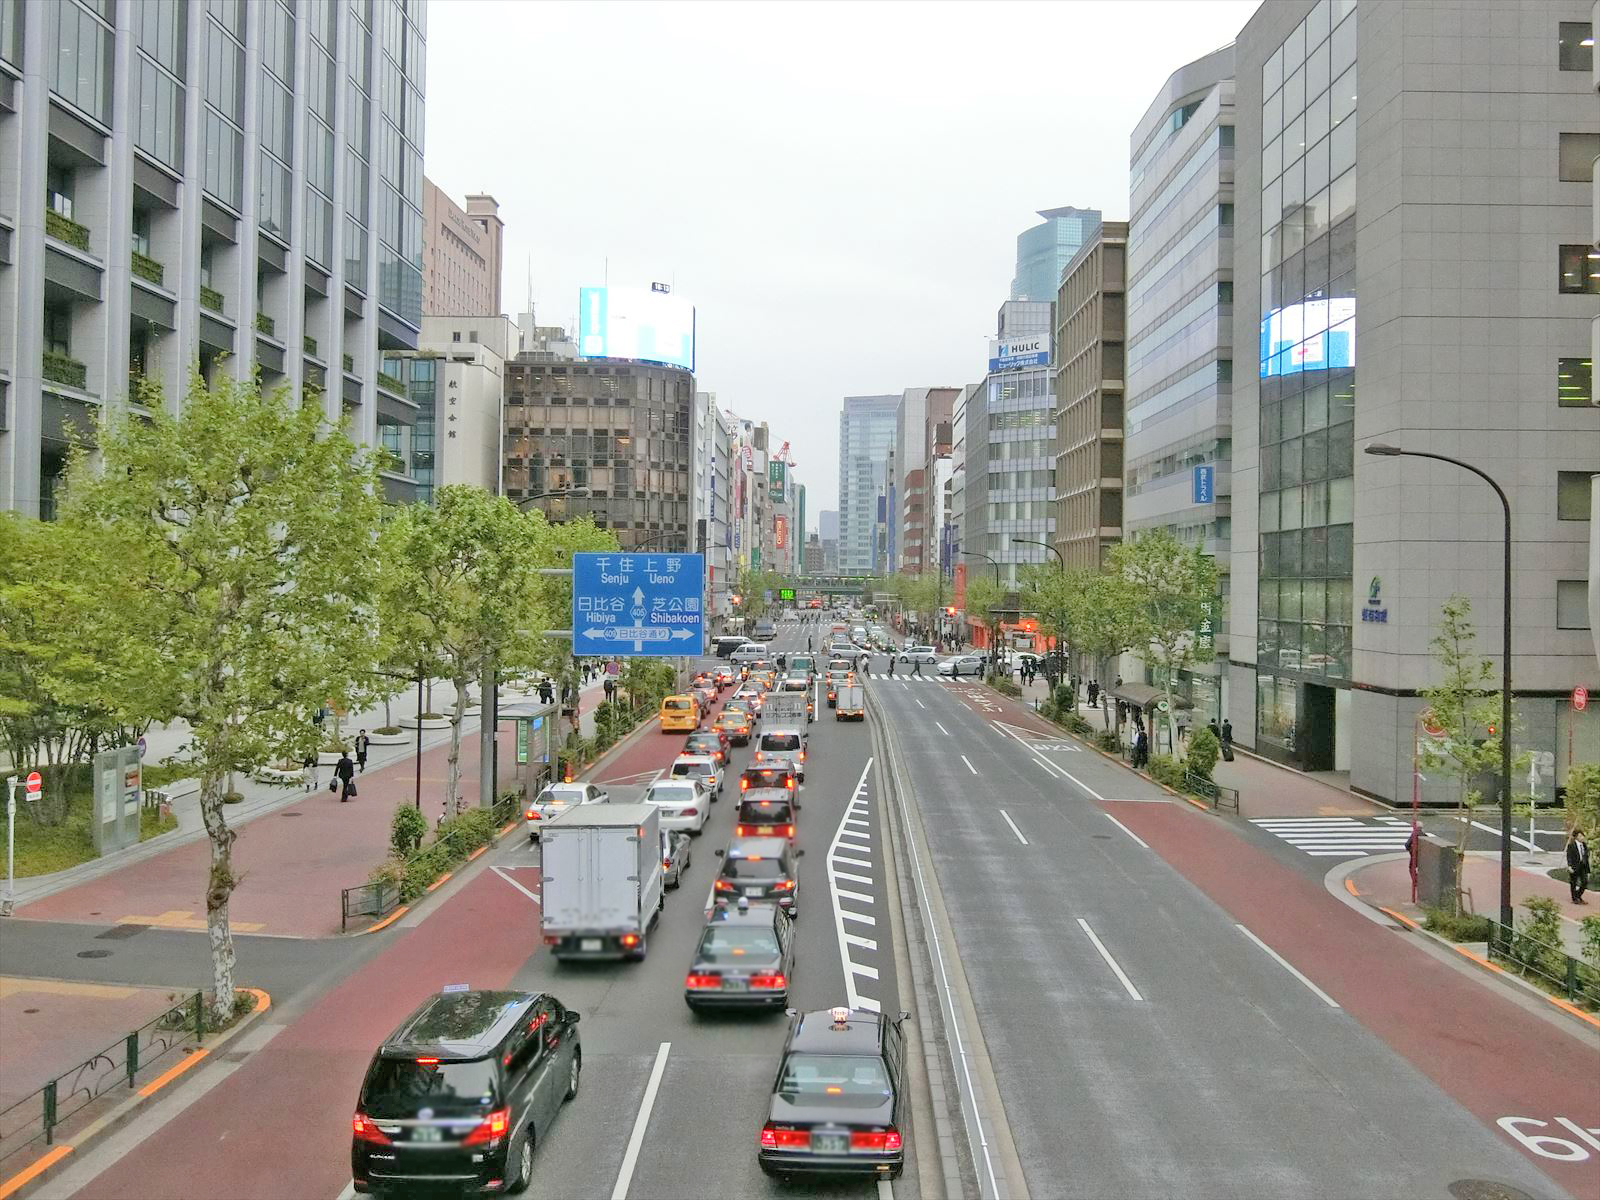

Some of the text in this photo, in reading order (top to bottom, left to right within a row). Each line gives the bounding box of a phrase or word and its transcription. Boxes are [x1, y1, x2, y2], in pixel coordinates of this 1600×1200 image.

[1011, 342, 1040, 353] HULIC
[596, 557, 681, 573] 千住 上野
[601, 572, 675, 586] Senju Ueno
[578, 596, 625, 612] 日比谷
[652, 597, 699, 612] 芝公園
[586, 611, 616, 625] Hibiya
[650, 612, 700, 624] Shibakoen
[619, 629, 668, 639] 日比谷通り
